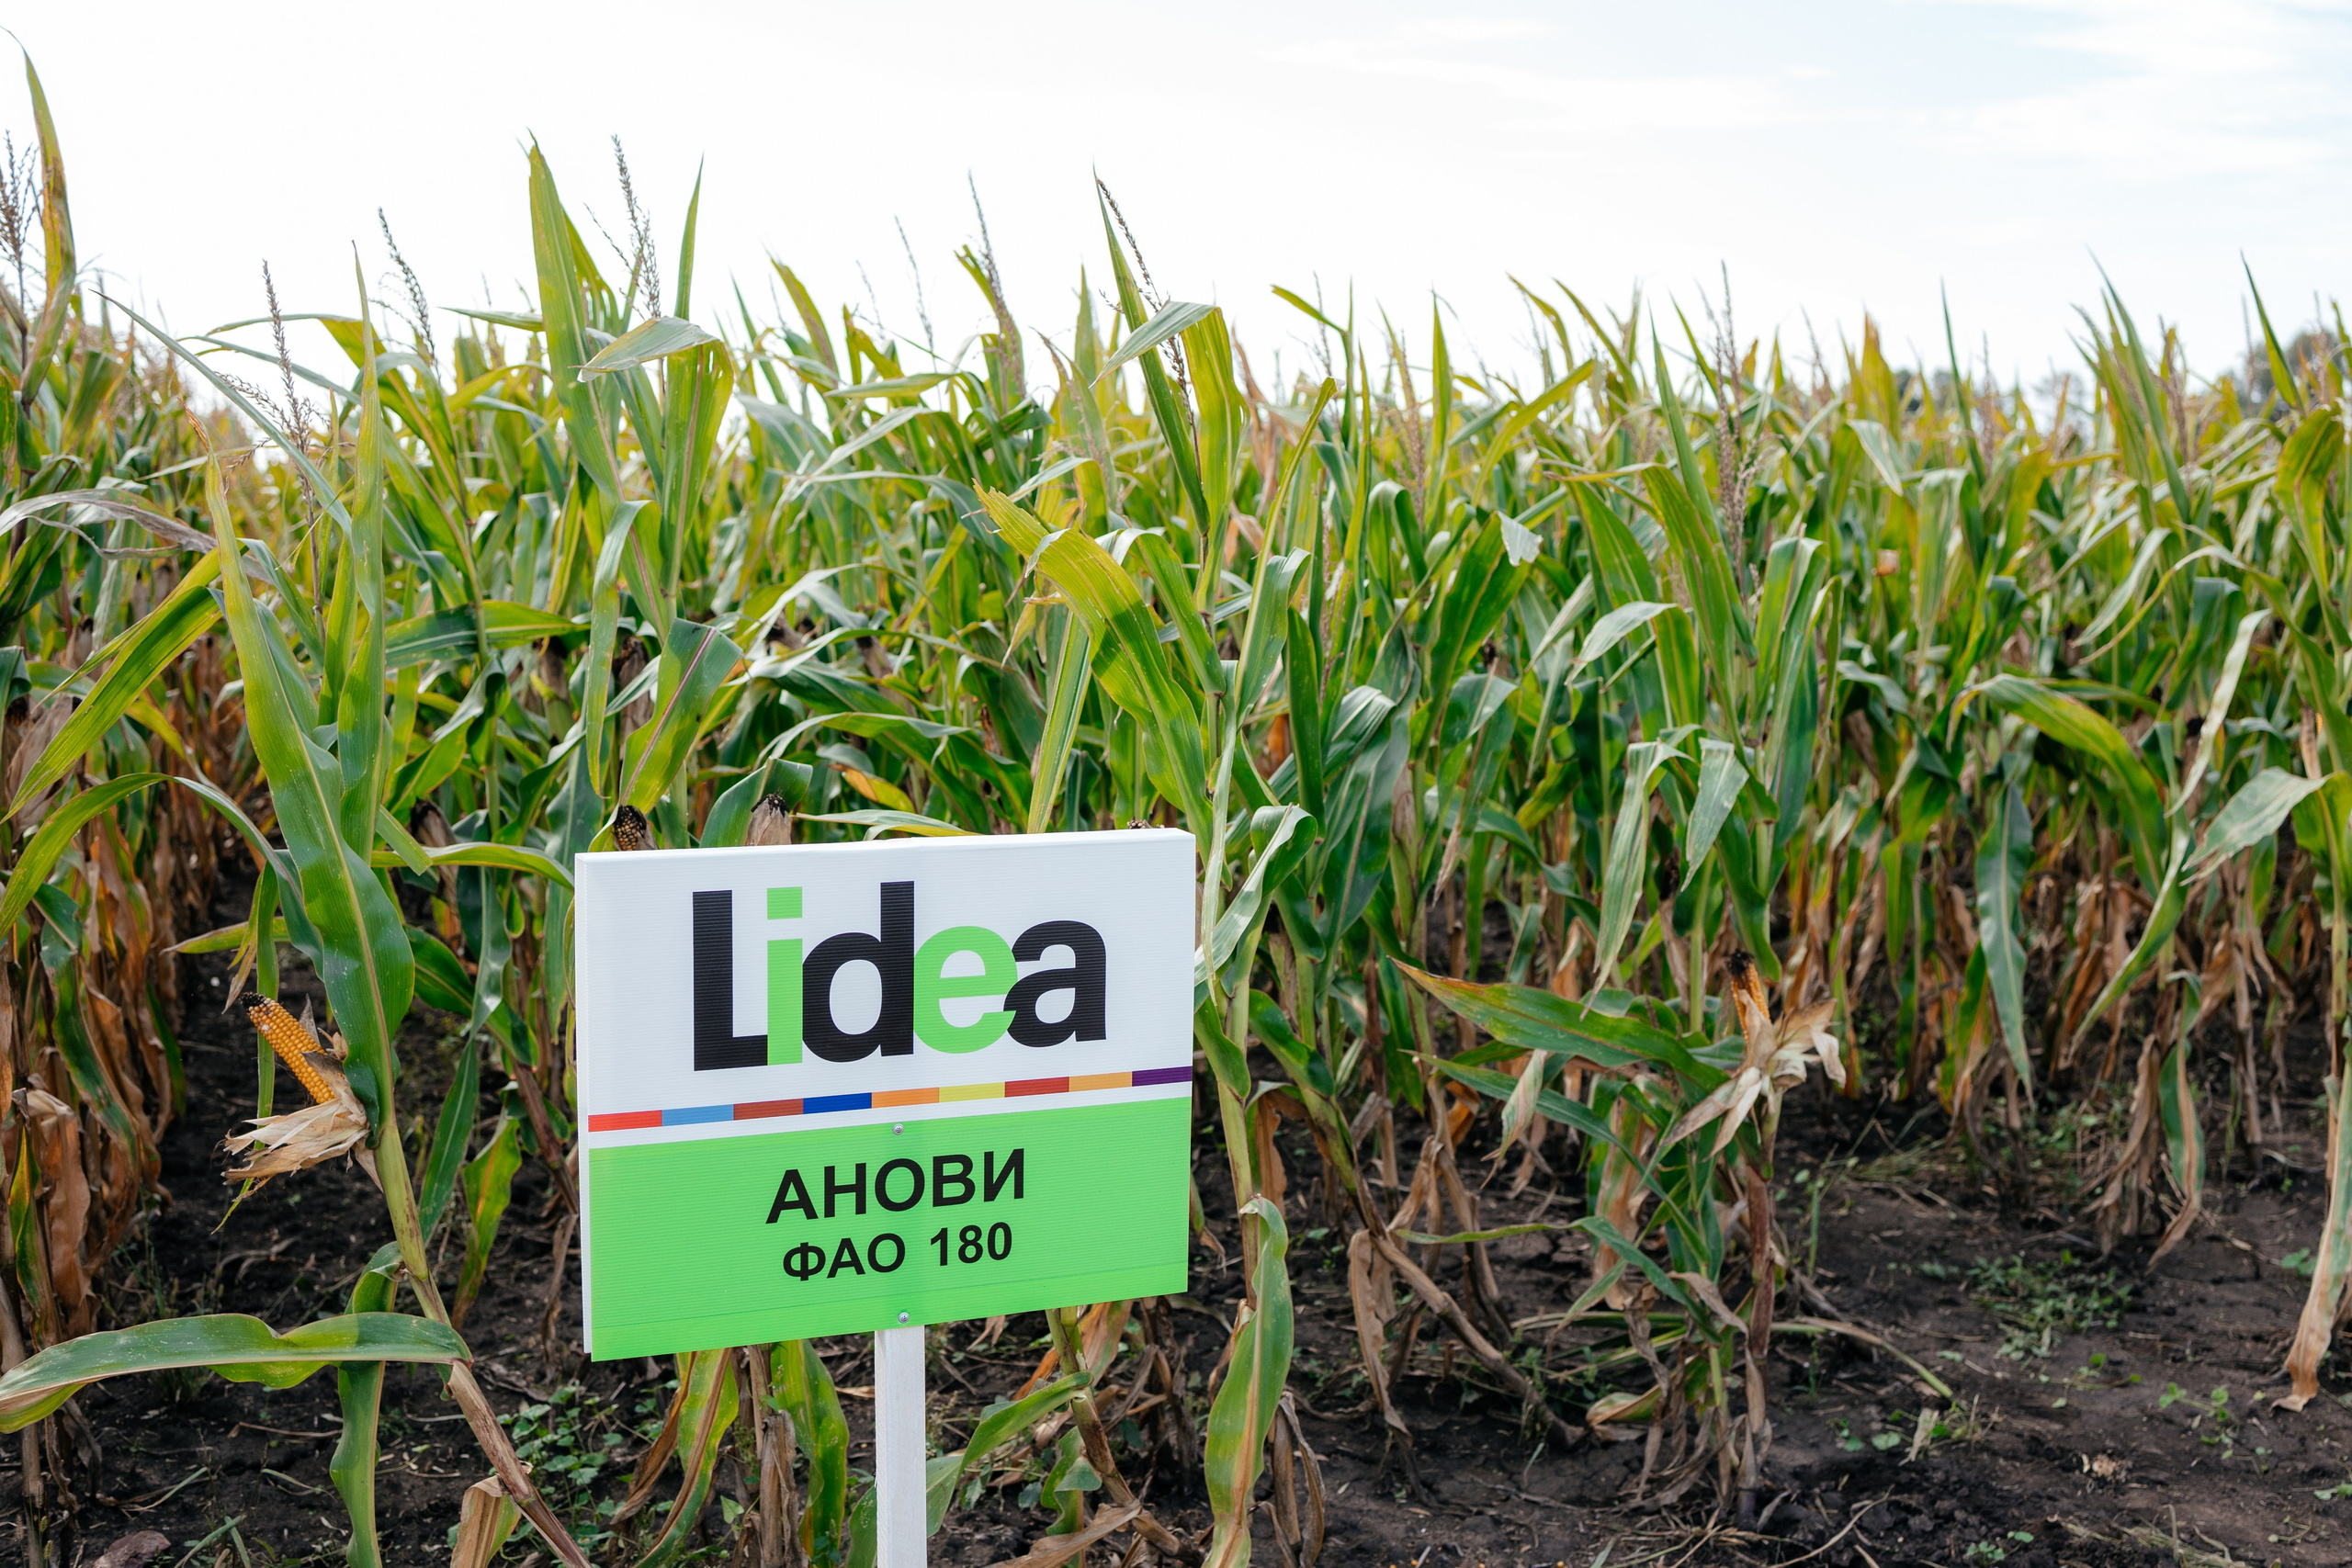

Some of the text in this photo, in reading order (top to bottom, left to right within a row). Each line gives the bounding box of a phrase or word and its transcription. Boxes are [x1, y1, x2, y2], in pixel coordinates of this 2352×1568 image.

[693, 881, 1106, 1071] Lidea
[765, 1148, 1024, 1224] АНОВИ
[783, 1222, 1013, 1281] ФАО 180
